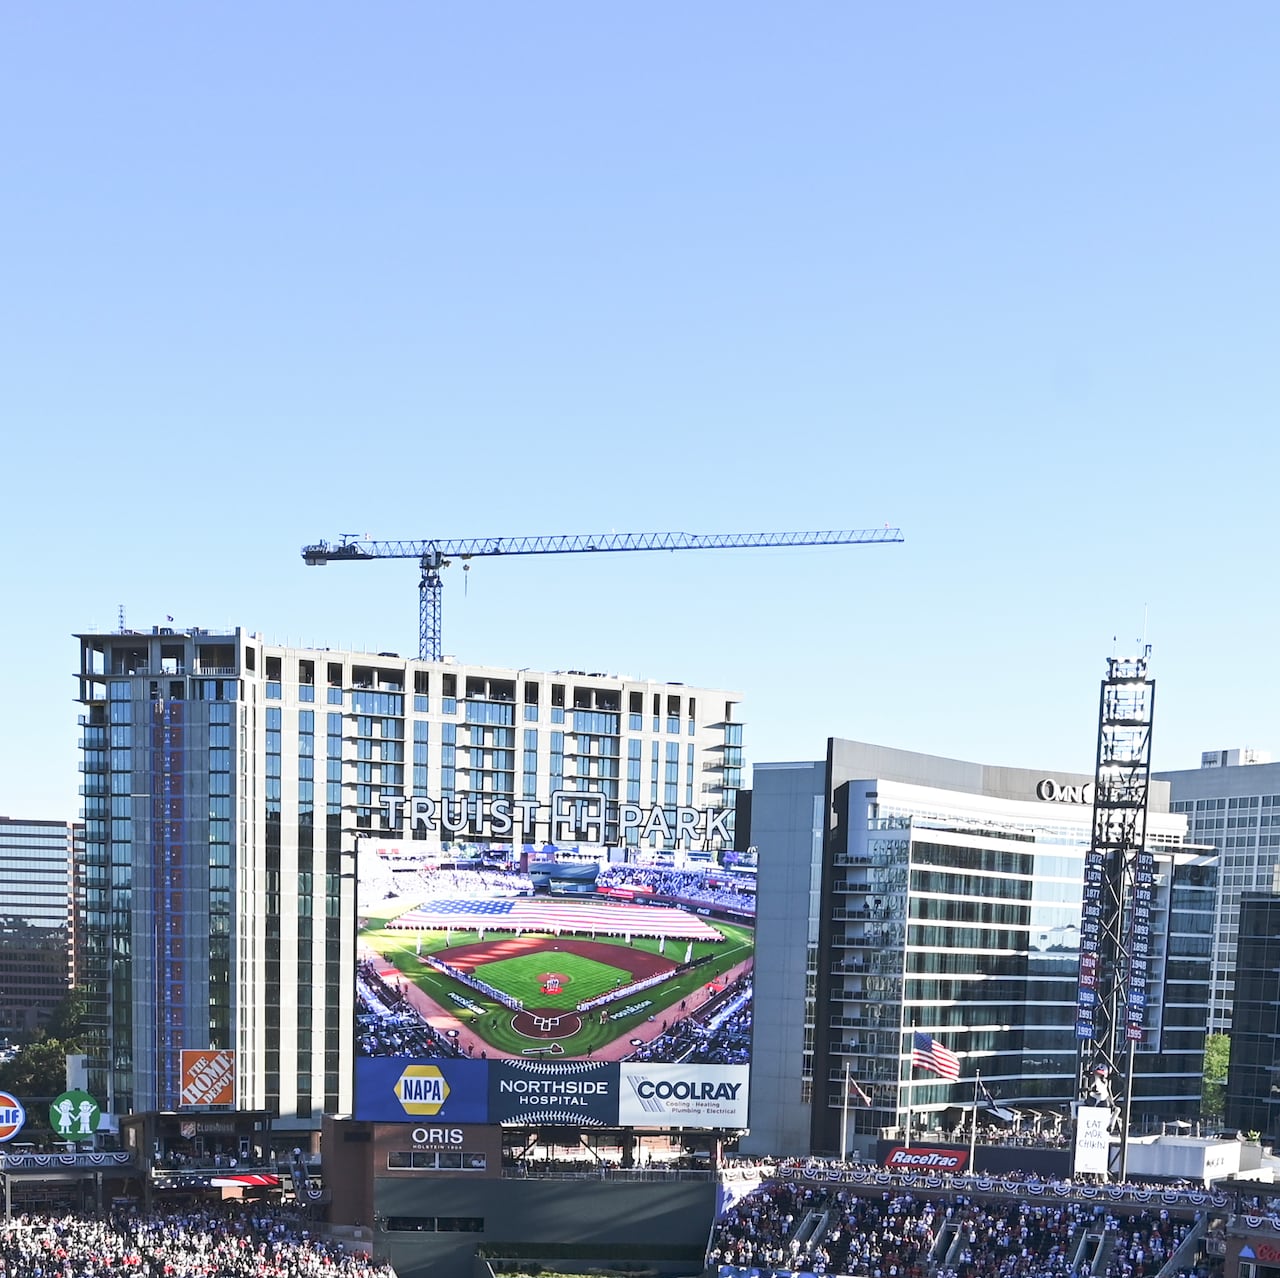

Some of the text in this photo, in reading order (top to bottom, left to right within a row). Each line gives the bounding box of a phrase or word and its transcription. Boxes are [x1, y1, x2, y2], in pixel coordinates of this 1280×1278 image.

[379, 794, 736, 842] TRUIST PARK
[1089, 854, 1102, 864] 1872
[1138, 854, 1153, 864] 1873
[1088, 870, 1102, 881] 1874
[1138, 872, 1152, 882] 1875
[1086, 888, 1100, 898] 1877
[1136, 890, 1150, 900] 1878
[1135, 906, 1149, 918] 1891
[1134, 924, 1148, 935] 1893
[1083, 940, 1097, 950] 1897
[1133, 942, 1148, 952] 1898
[1082, 958, 1096, 968] 1914
[1080, 975, 1095, 986] 1957
[1130, 977, 1145, 988] 1958
[1129, 994, 1144, 1004] 1982
[1078, 1009, 1092, 1020] 1991
[1128, 1011, 1143, 1022] 1992
[1078, 1026, 1092, 1036] 1993
[1127, 1028, 1142, 1039] 1995
[186, 1055, 209, 1077] THE
[182, 1050, 235, 1105] HOME
[203, 1071, 235, 1105] DEPOT
[402, 1079, 442, 1101] NAPA
[500, 1079, 609, 1095] NORTHSIDE
[637, 1081, 742, 1101] COOLRAY
[519, 1096, 589, 1106] HOSPITAL
[411, 1127, 464, 1144] ORIS
[891, 1150, 959, 1168] RaceTrac
